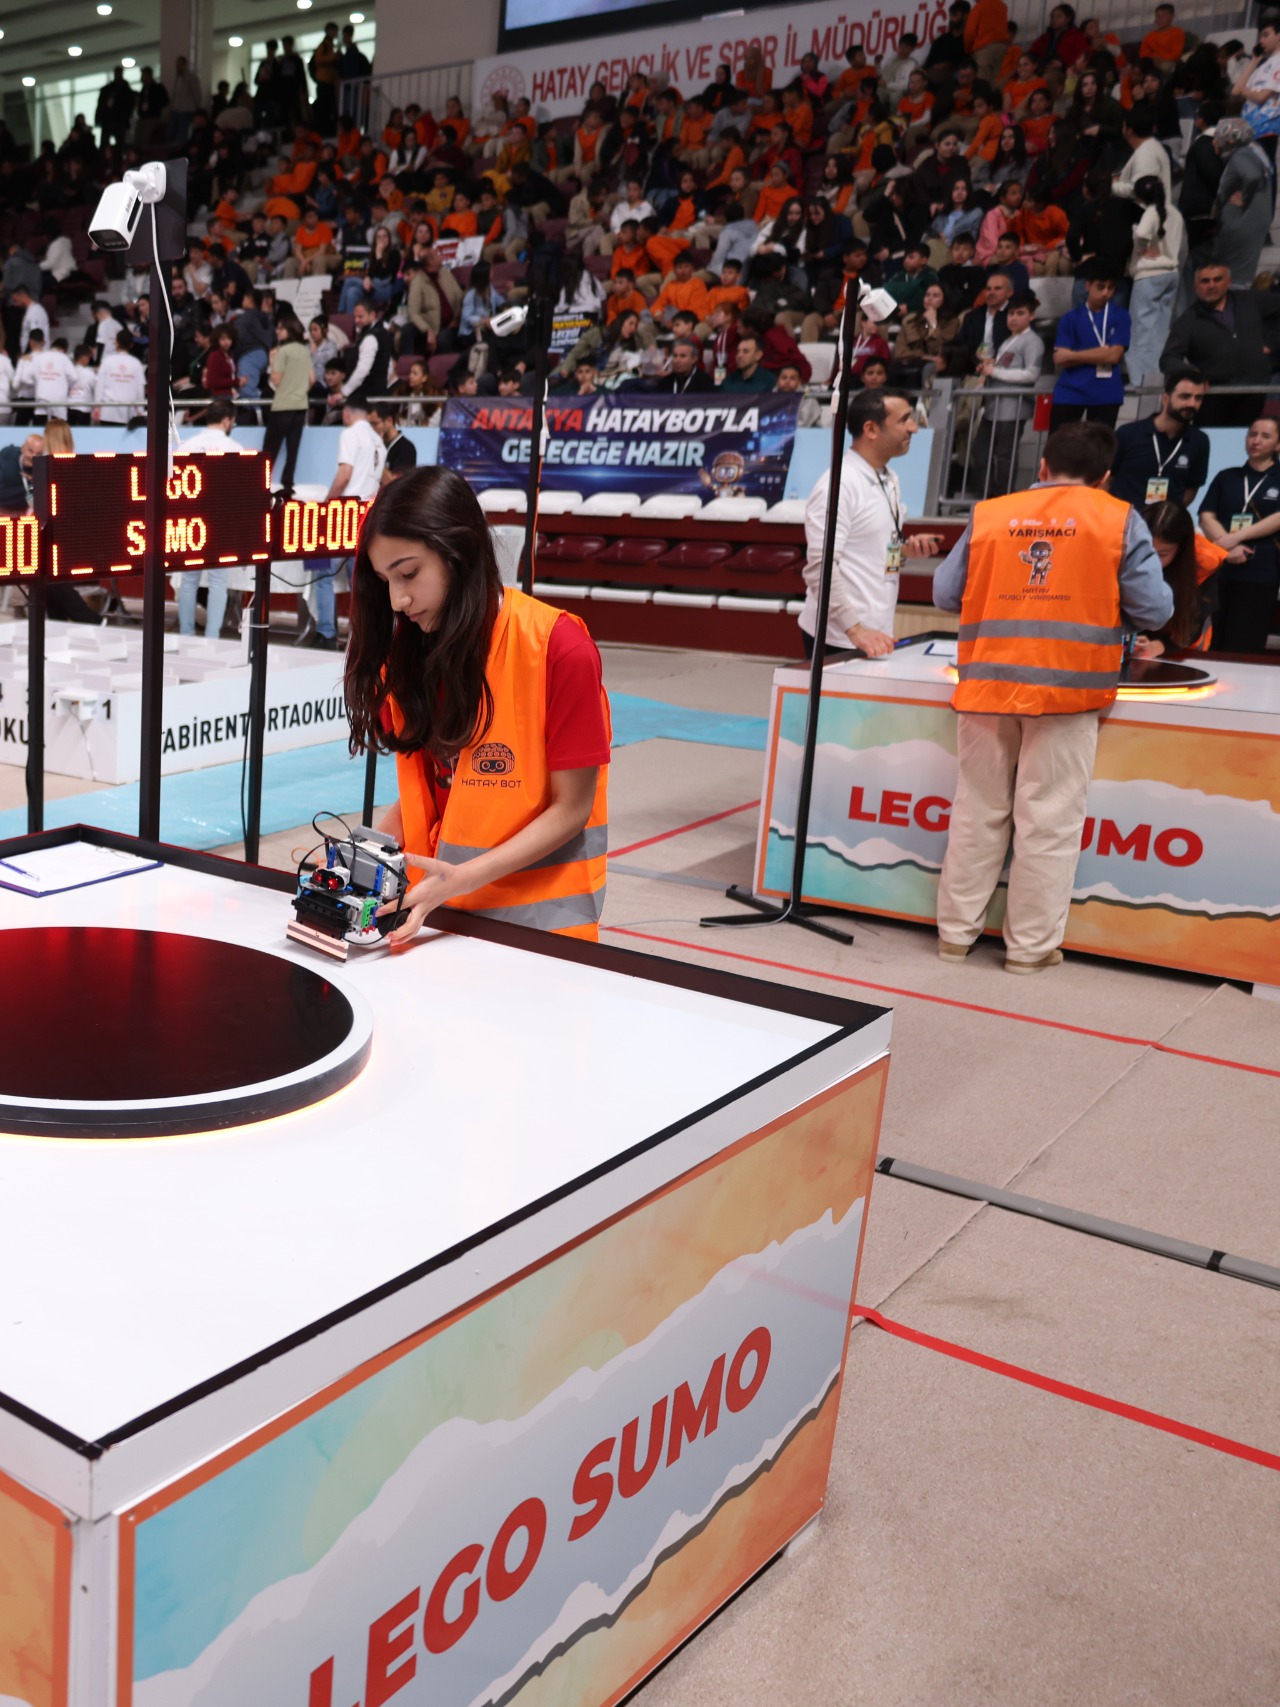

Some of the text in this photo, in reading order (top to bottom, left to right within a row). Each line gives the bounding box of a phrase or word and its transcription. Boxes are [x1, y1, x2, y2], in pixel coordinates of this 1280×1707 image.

[532, 64, 591, 102] HATAY
[686, 44, 711, 80] VE
[784, 23, 803, 68] İL
[811, 0, 947, 62] MÜDÜRLÜĞ
[585, 407, 759, 433] HATAYBOT'LA
[501, 436, 705, 467] GEECEĞE HAZIR
[131, 465, 202, 501] LGO
[127, 517, 206, 556] SMO
[283, 500, 375, 553] 00:00:
[1008, 528, 1076, 539] YARIŞMACI
[101, 699, 112, 720] 1
[162, 696, 346, 753] ABİRENT RTAOKUL
[462, 778, 522, 788] HATAY BOT
[848, 786, 953, 832] LEG
[308, 1326, 772, 1707] LEGO SUMO
